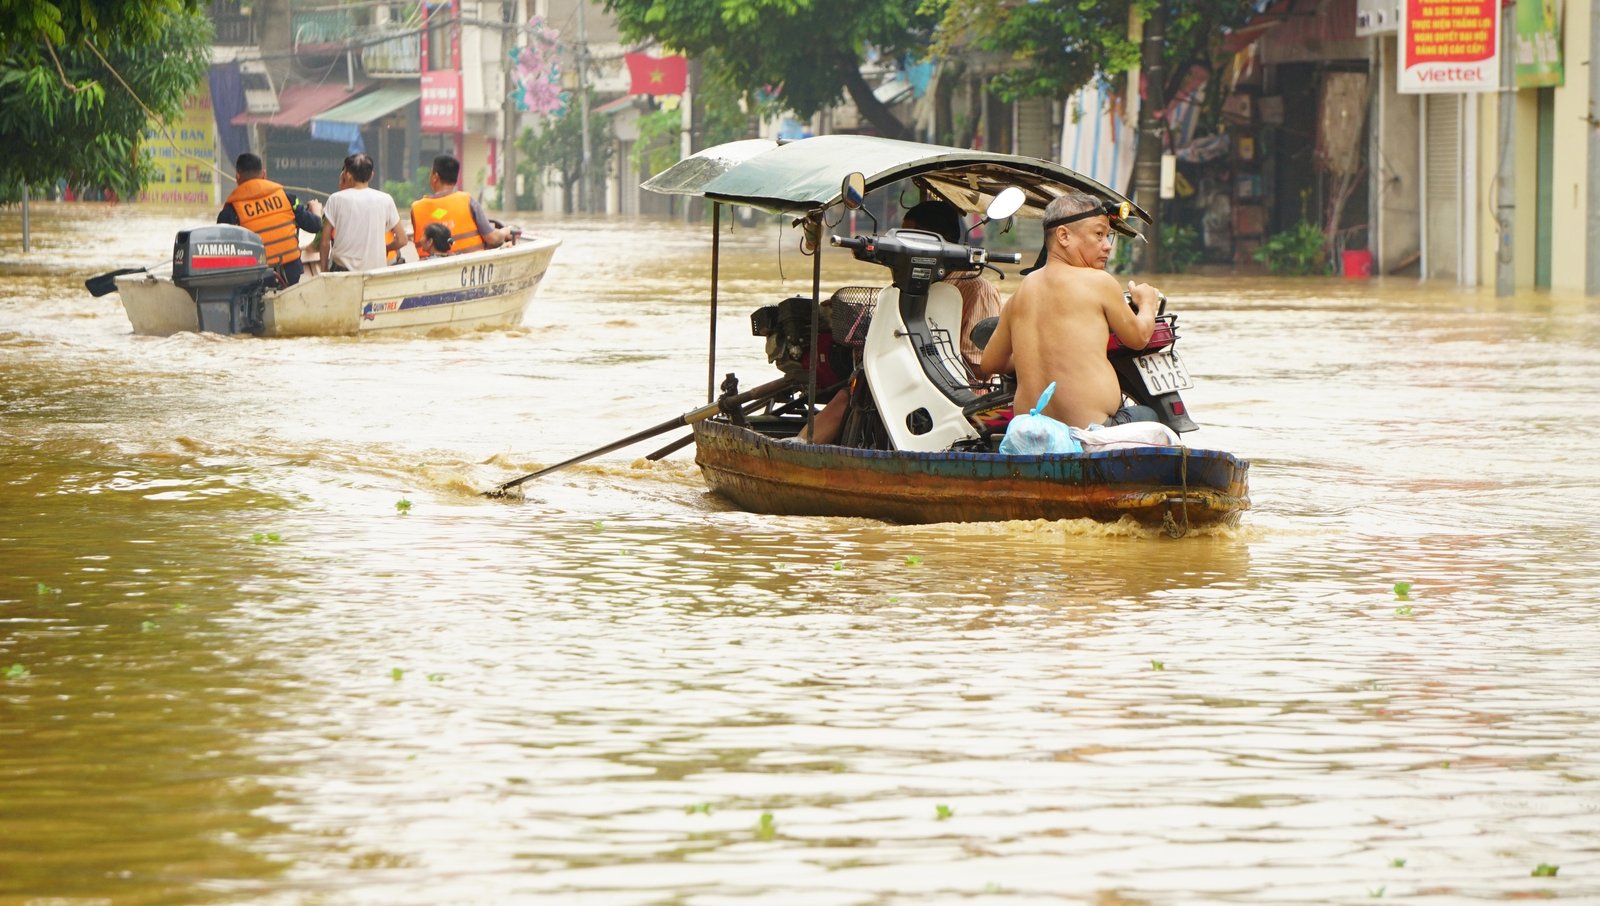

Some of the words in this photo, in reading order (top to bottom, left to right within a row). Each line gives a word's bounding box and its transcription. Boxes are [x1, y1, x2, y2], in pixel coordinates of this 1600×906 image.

[1416, 67, 1483, 81] viettel
[244, 196, 283, 217] CAND
[197, 244, 236, 256] YAMAHA
[1151, 370, 1187, 392] 0125
